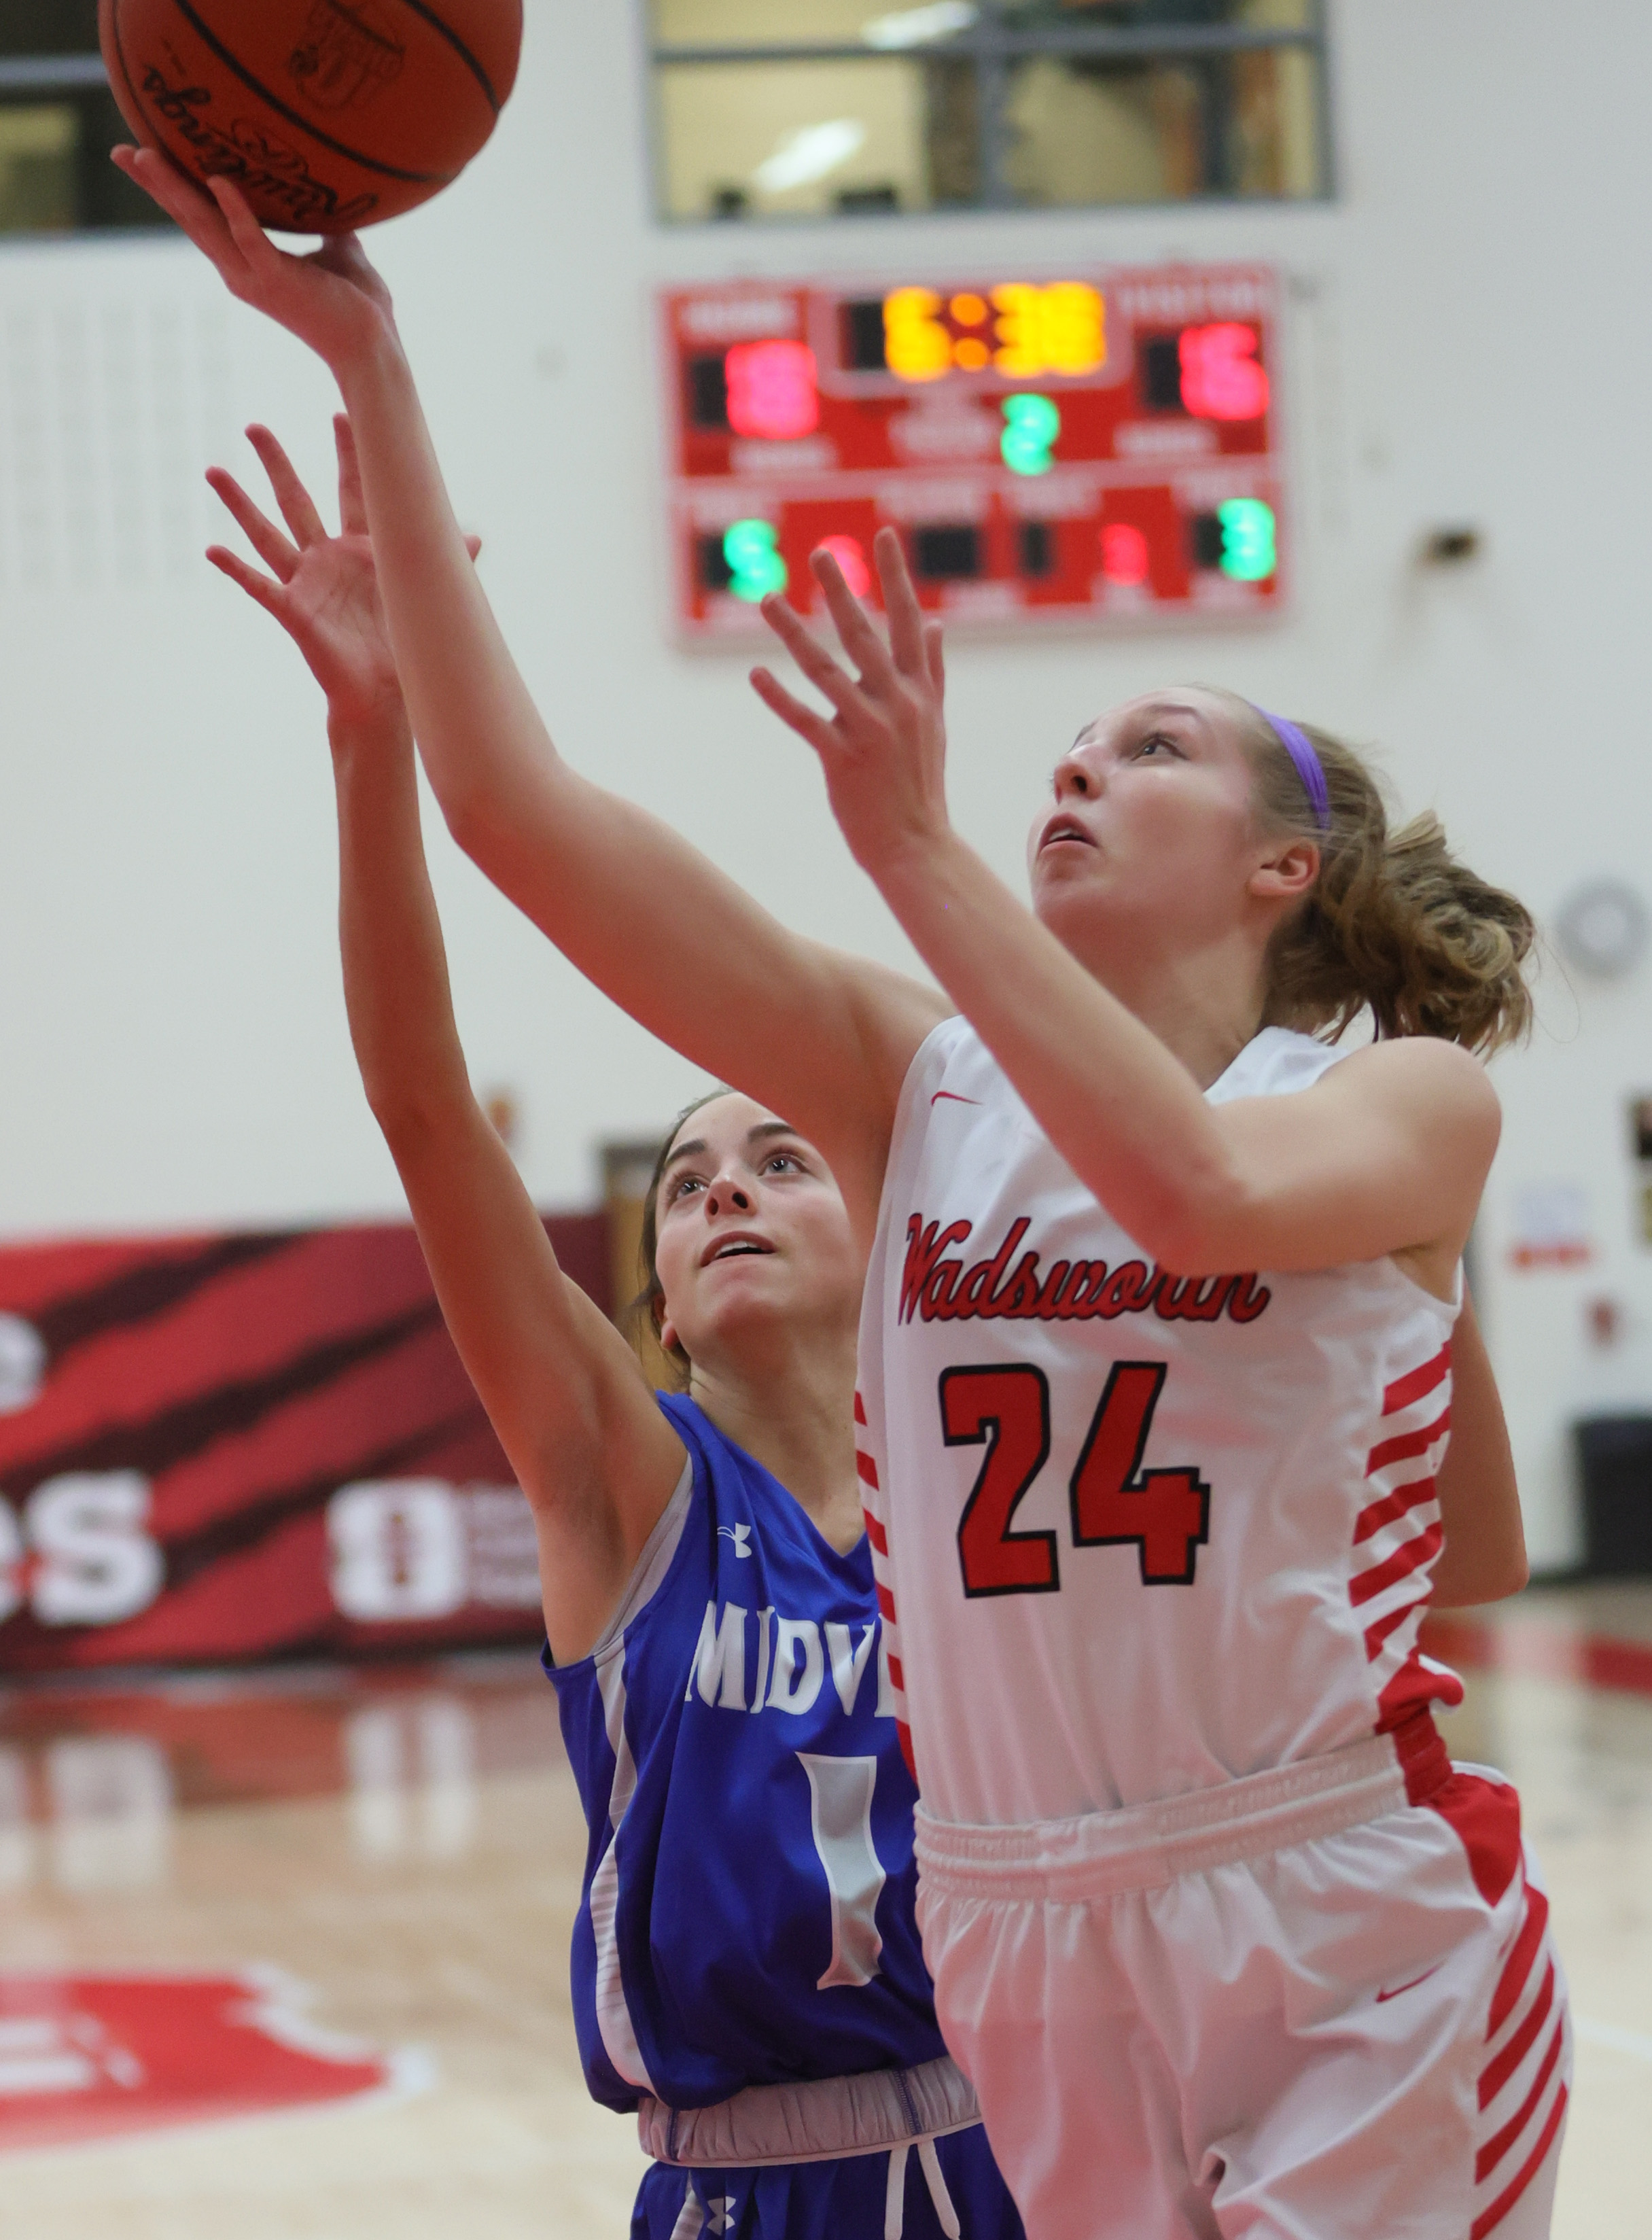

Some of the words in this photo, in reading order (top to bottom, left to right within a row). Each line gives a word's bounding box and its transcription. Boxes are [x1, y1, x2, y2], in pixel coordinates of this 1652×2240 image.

[1000, 392, 1060, 476] 2
[938, 1361, 1210, 1598] 24
[795, 1751, 885, 1991] 1
